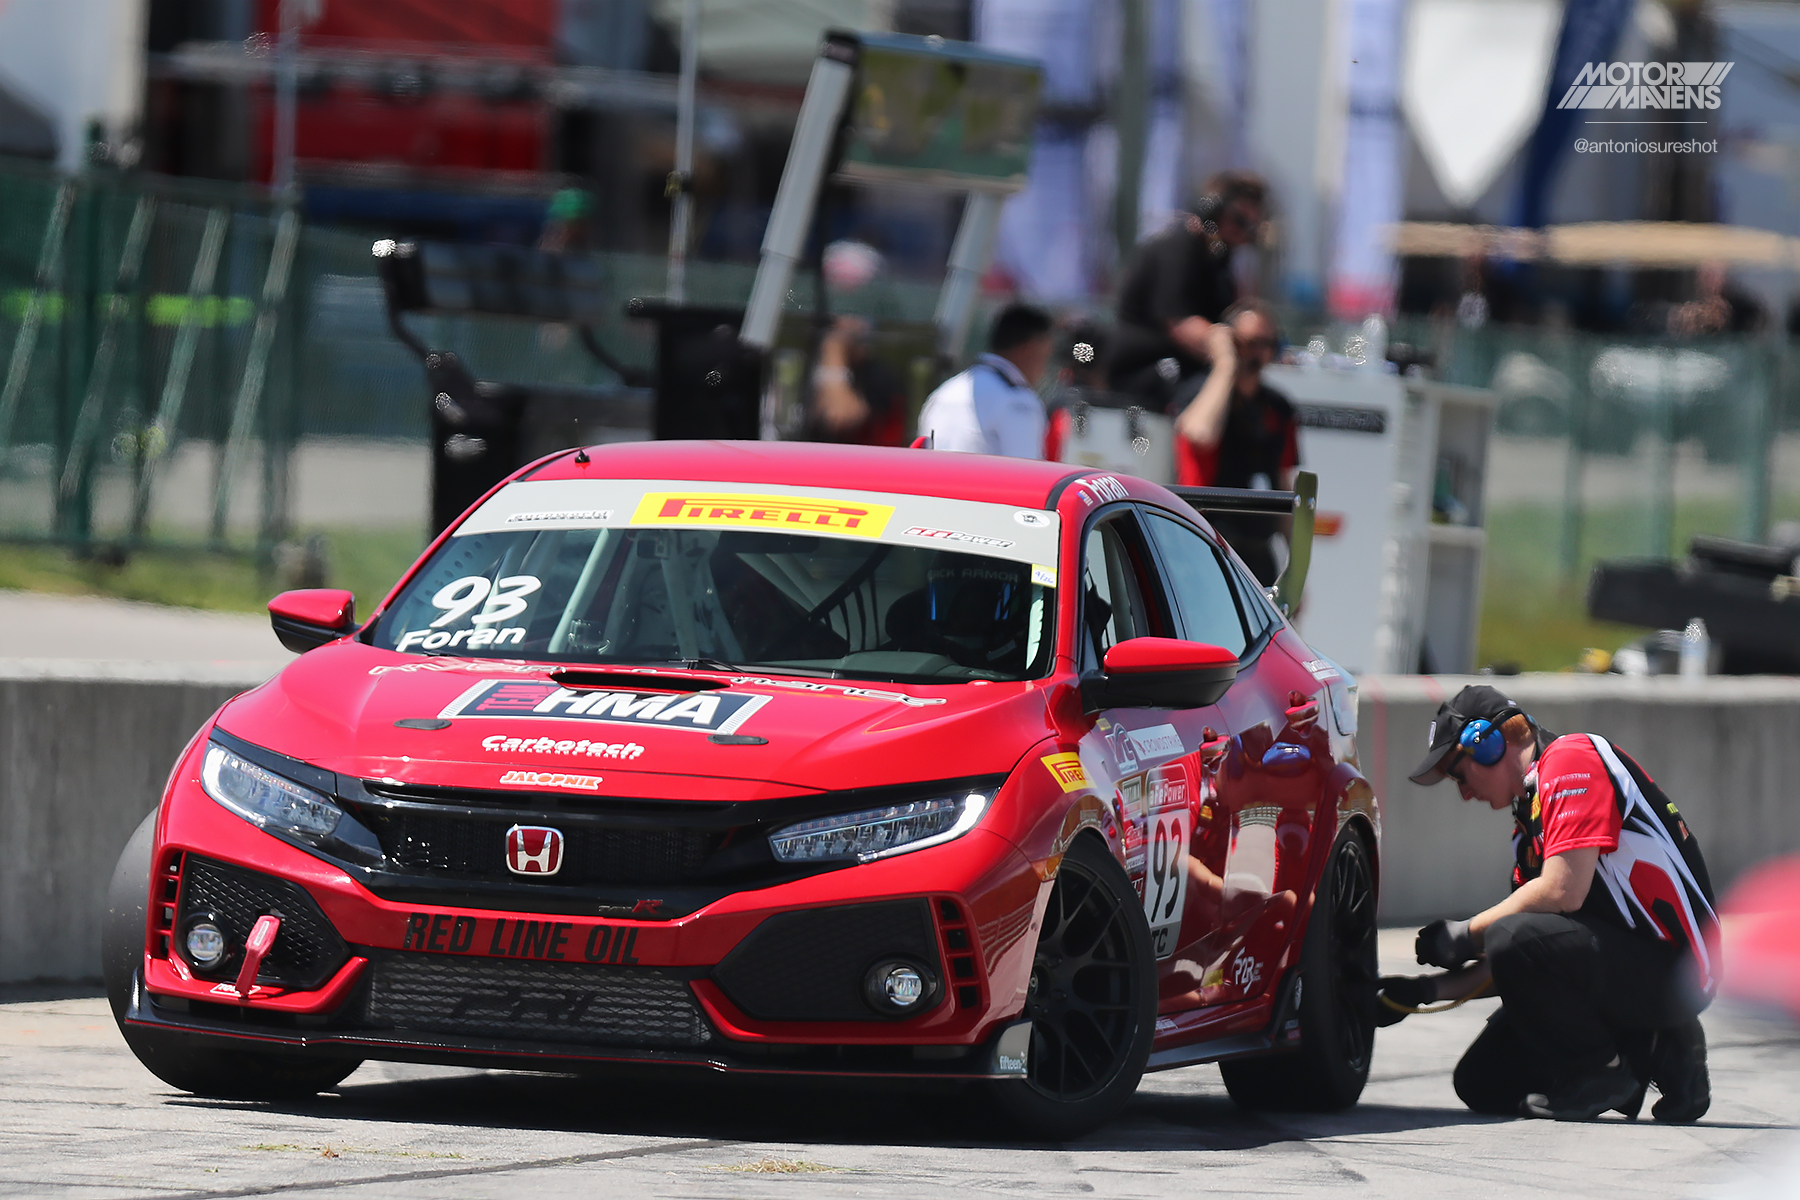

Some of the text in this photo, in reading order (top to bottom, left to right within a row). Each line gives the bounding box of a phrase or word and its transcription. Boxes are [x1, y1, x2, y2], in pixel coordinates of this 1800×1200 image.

[657, 498, 869, 529] PIRELLI
[429, 575, 542, 628] 93
[395, 626, 527, 652] Foran
[532, 686, 722, 725] HMA
[481, 735, 645, 757] Carbotech
[501, 771, 602, 789] JALOPNIK
[1153, 818, 1182, 923] 93
[403, 912, 639, 965] RED LINE OIL
